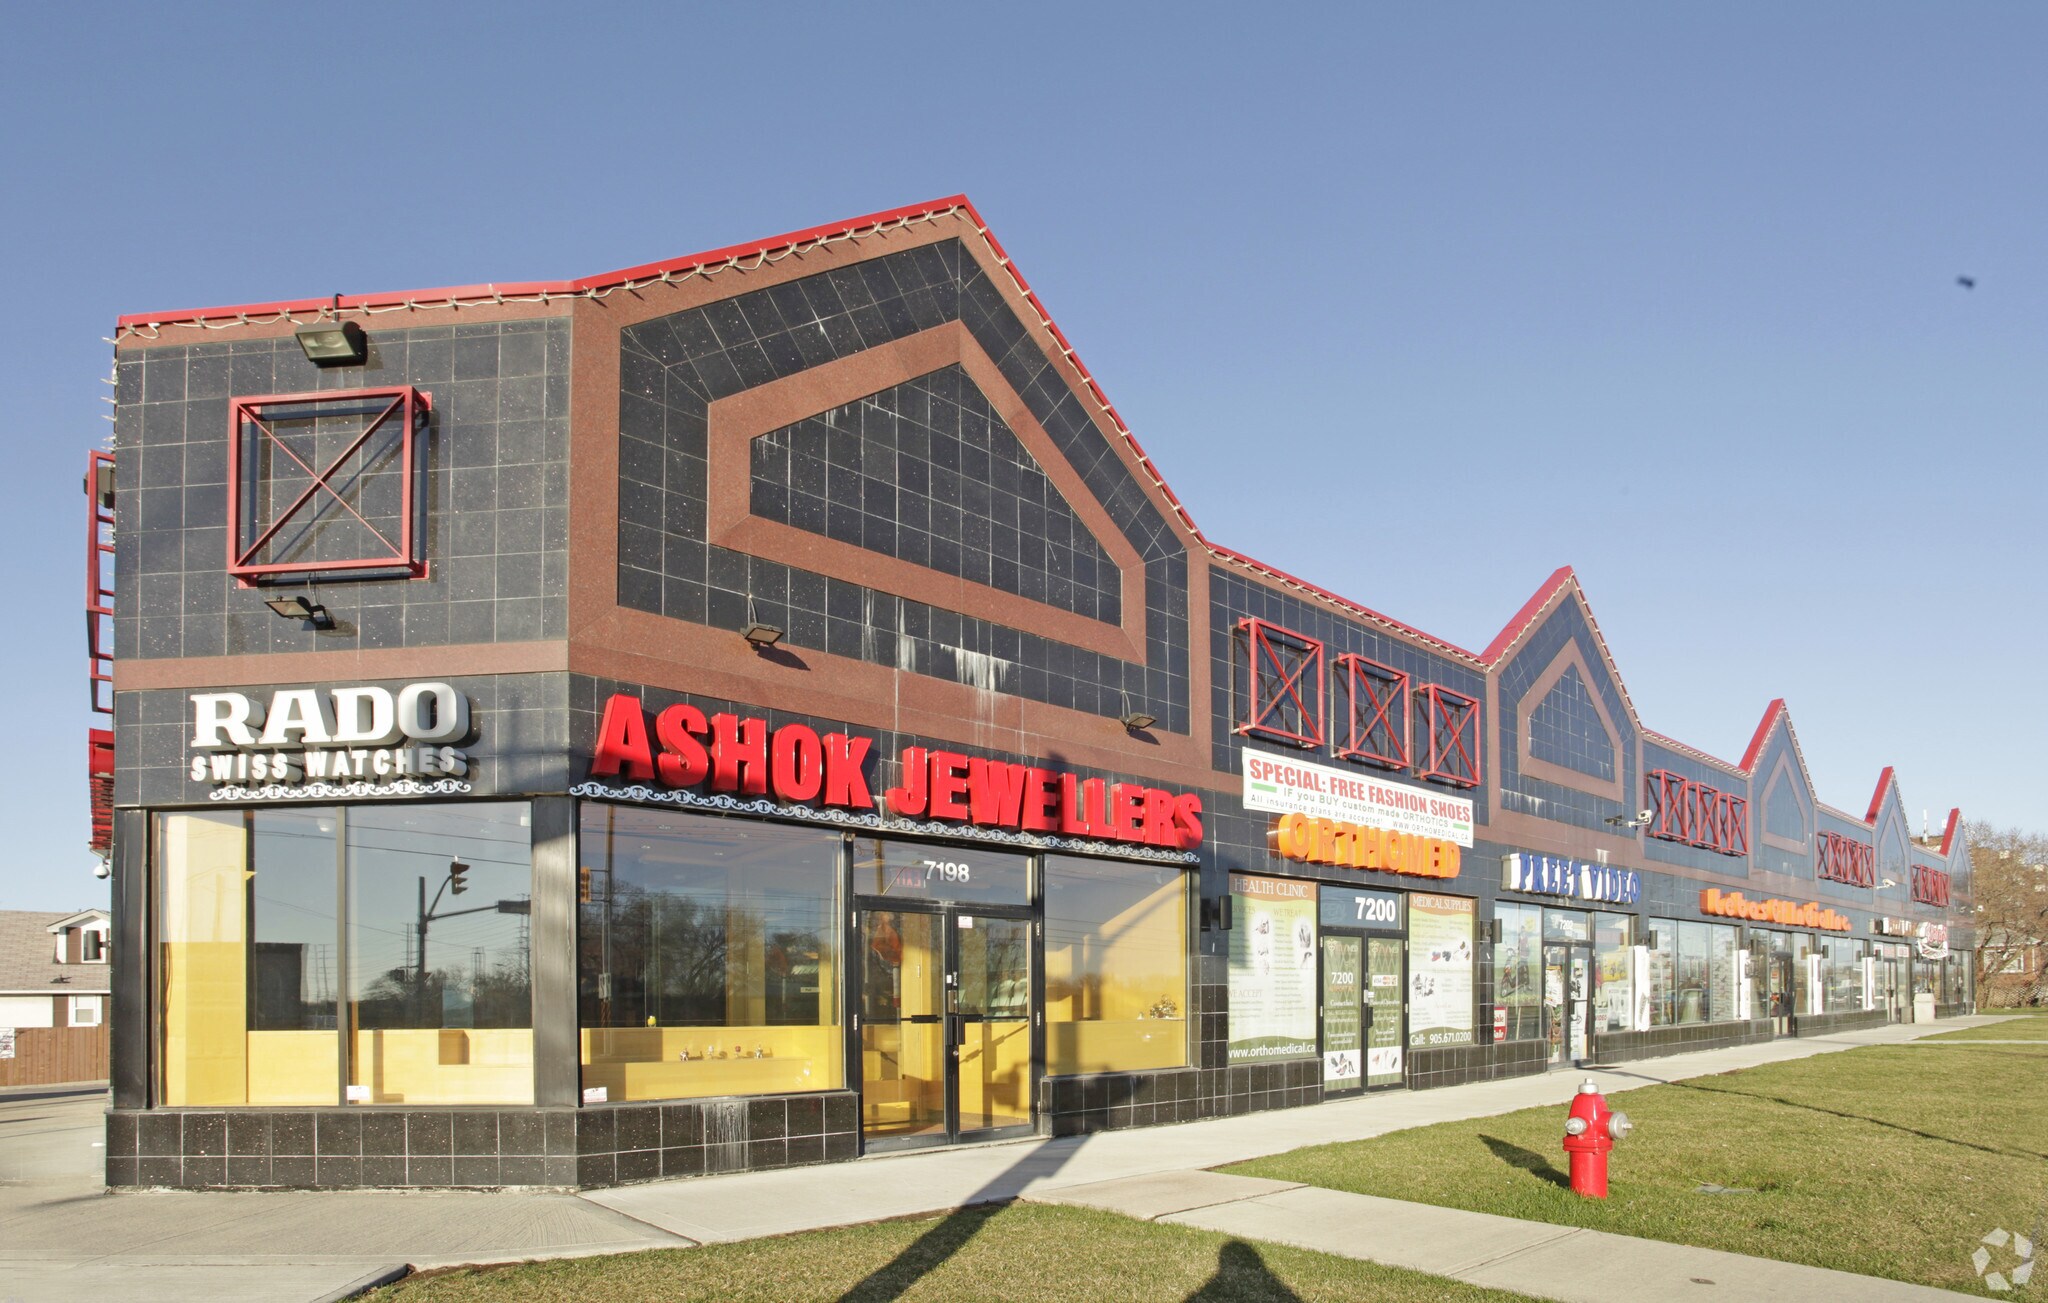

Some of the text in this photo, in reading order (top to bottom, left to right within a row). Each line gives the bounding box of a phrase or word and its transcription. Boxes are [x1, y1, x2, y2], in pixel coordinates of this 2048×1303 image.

[190, 682, 469, 749] RADO
[190, 746, 466, 783] SWISS WATCHES
[591, 693, 1204, 850] ASHOK JEWELLERS
[1249, 758, 1471, 823] SPECIAL: FREE FASHION SHOES
[1251, 794, 1263, 803] All
[1266, 796, 1307, 812] insurance
[1310, 805, 1331, 816] plans
[1334, 811, 1346, 819] are
[1283, 787, 1449, 828] IF you BUY custom made ORTHOTICS
[1277, 812, 1462, 879] ORTHOMED
[923, 860, 970, 883] 7198
[1508, 852, 1642, 904] PREET VIDEO
[1234, 878, 1309, 898] HEALTH CLINIC
[1355, 896, 1396, 922] 7200
[1412, 895, 1472, 913] MEDICAL SUPPLIES
[1331, 971, 1354, 985] 7200
[1228, 1042, 1316, 1059] www.orthomedical.ca
[1409, 1033, 1426, 1046] Call:
[1429, 1031, 1472, 1045] 905.671.0200
